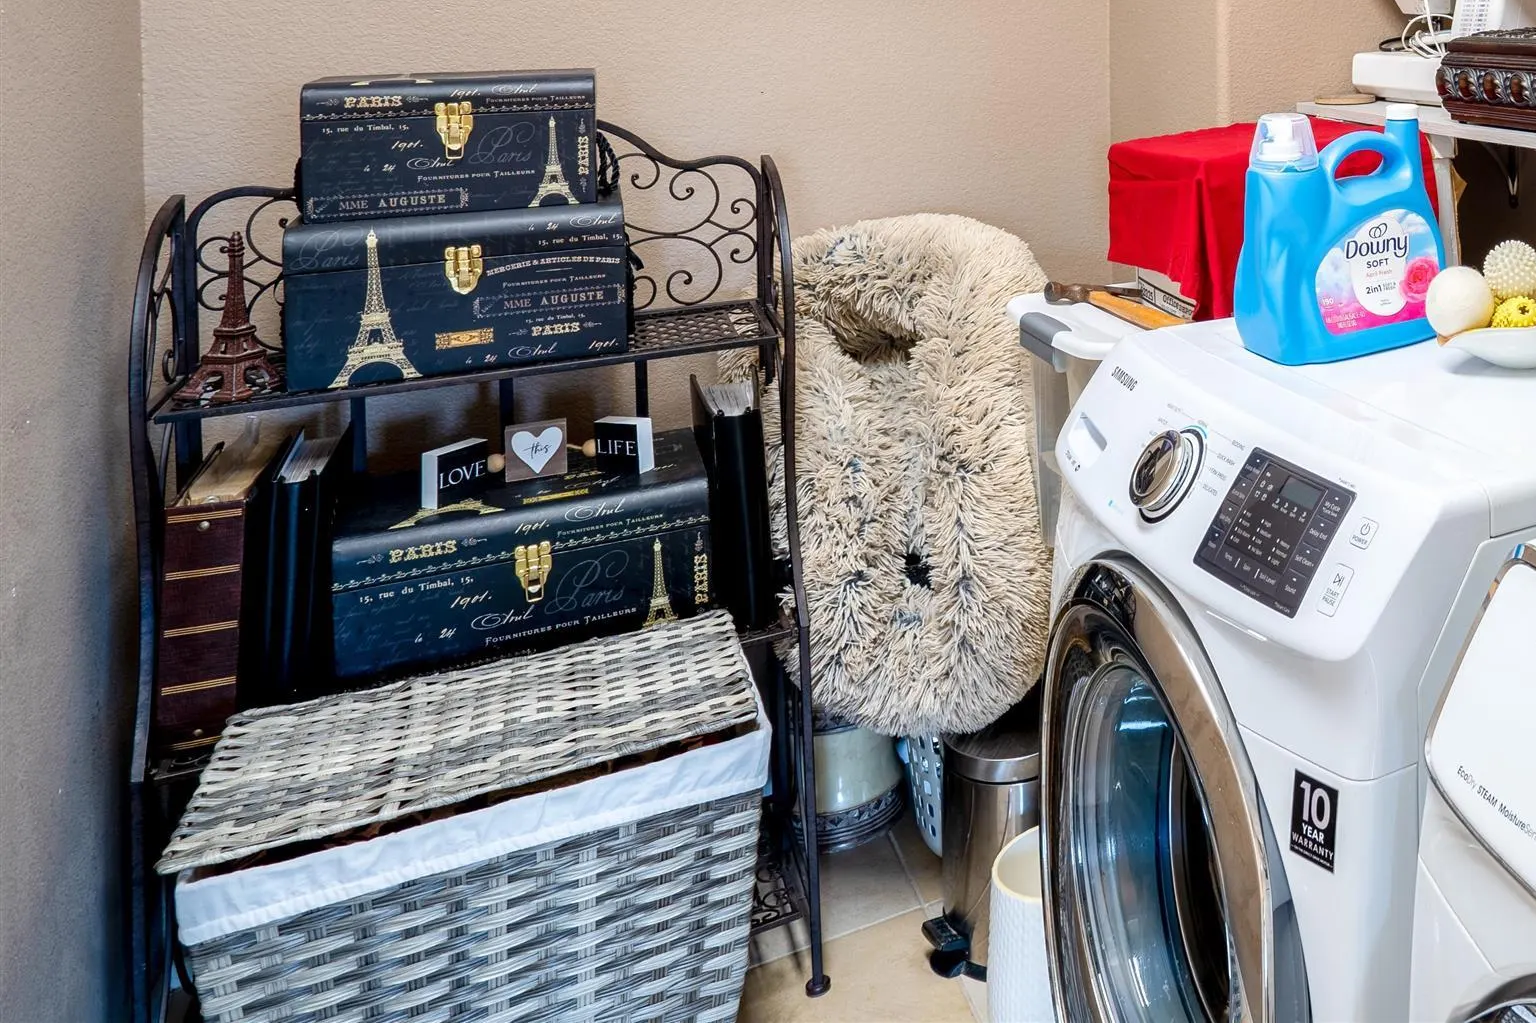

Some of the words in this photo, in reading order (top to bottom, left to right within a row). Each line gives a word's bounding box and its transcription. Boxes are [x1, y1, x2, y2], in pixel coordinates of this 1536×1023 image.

[344, 95, 403, 109] PARIS
[578, 135, 589, 175] PARIS
[339, 199, 369, 210] MME
[378, 194, 446, 208] AUGUSTE
[1345, 235, 1408, 259] Downy
[486, 261, 532, 277] MERCERIE
[539, 256, 582, 265] ARTICLES
[595, 256, 621, 264] PARIS
[1366, 257, 1390, 269] SOFT
[503, 299, 532, 310] MME
[540, 291, 604, 306] AUGUSTE
[531, 322, 581, 337] PARIS
[1111, 365, 1139, 392] SAMSUNG
[523, 442, 553, 459] this
[597, 438, 637, 456] LIFE
[439, 458, 487, 489] LOVE
[389, 539, 458, 564] PARIS
[694, 553, 709, 605] PARIS
[378, 591, 396, 600] rue
[401, 586, 415, 595] du
[485, 624, 553, 647] FOURNITURES
[555, 619, 581, 630] POUR
[583, 607, 638, 626] TAILLEURS
[1300, 779, 1331, 830] 10
[1476, 785, 1498, 808] STEAM
[1302, 822, 1325, 845] YEAR
[1291, 831, 1334, 861] WARRANTY
